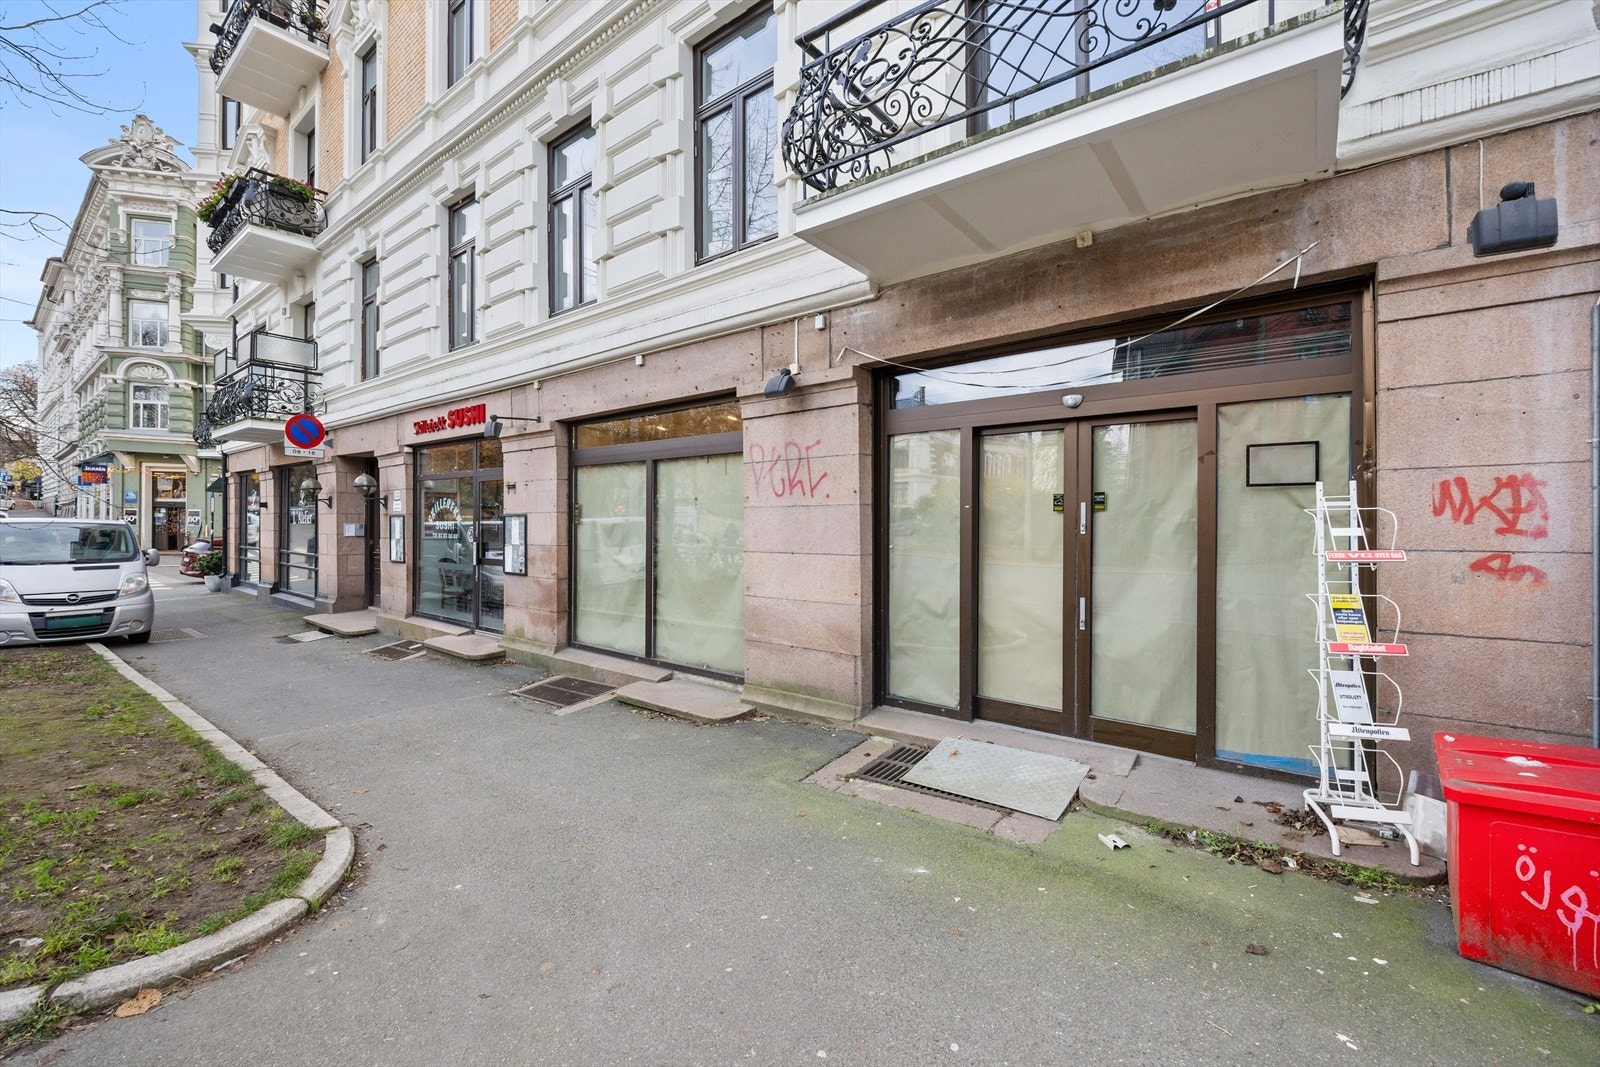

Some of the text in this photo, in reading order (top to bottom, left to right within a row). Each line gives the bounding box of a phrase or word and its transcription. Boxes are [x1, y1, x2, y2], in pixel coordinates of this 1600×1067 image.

[447, 403, 486, 429] SUSHI
[435, 520, 455, 530] SUSHI
[1347, 643, 1387, 653] Dagbladet
[1351, 726, 1390, 736] Aftenposten
